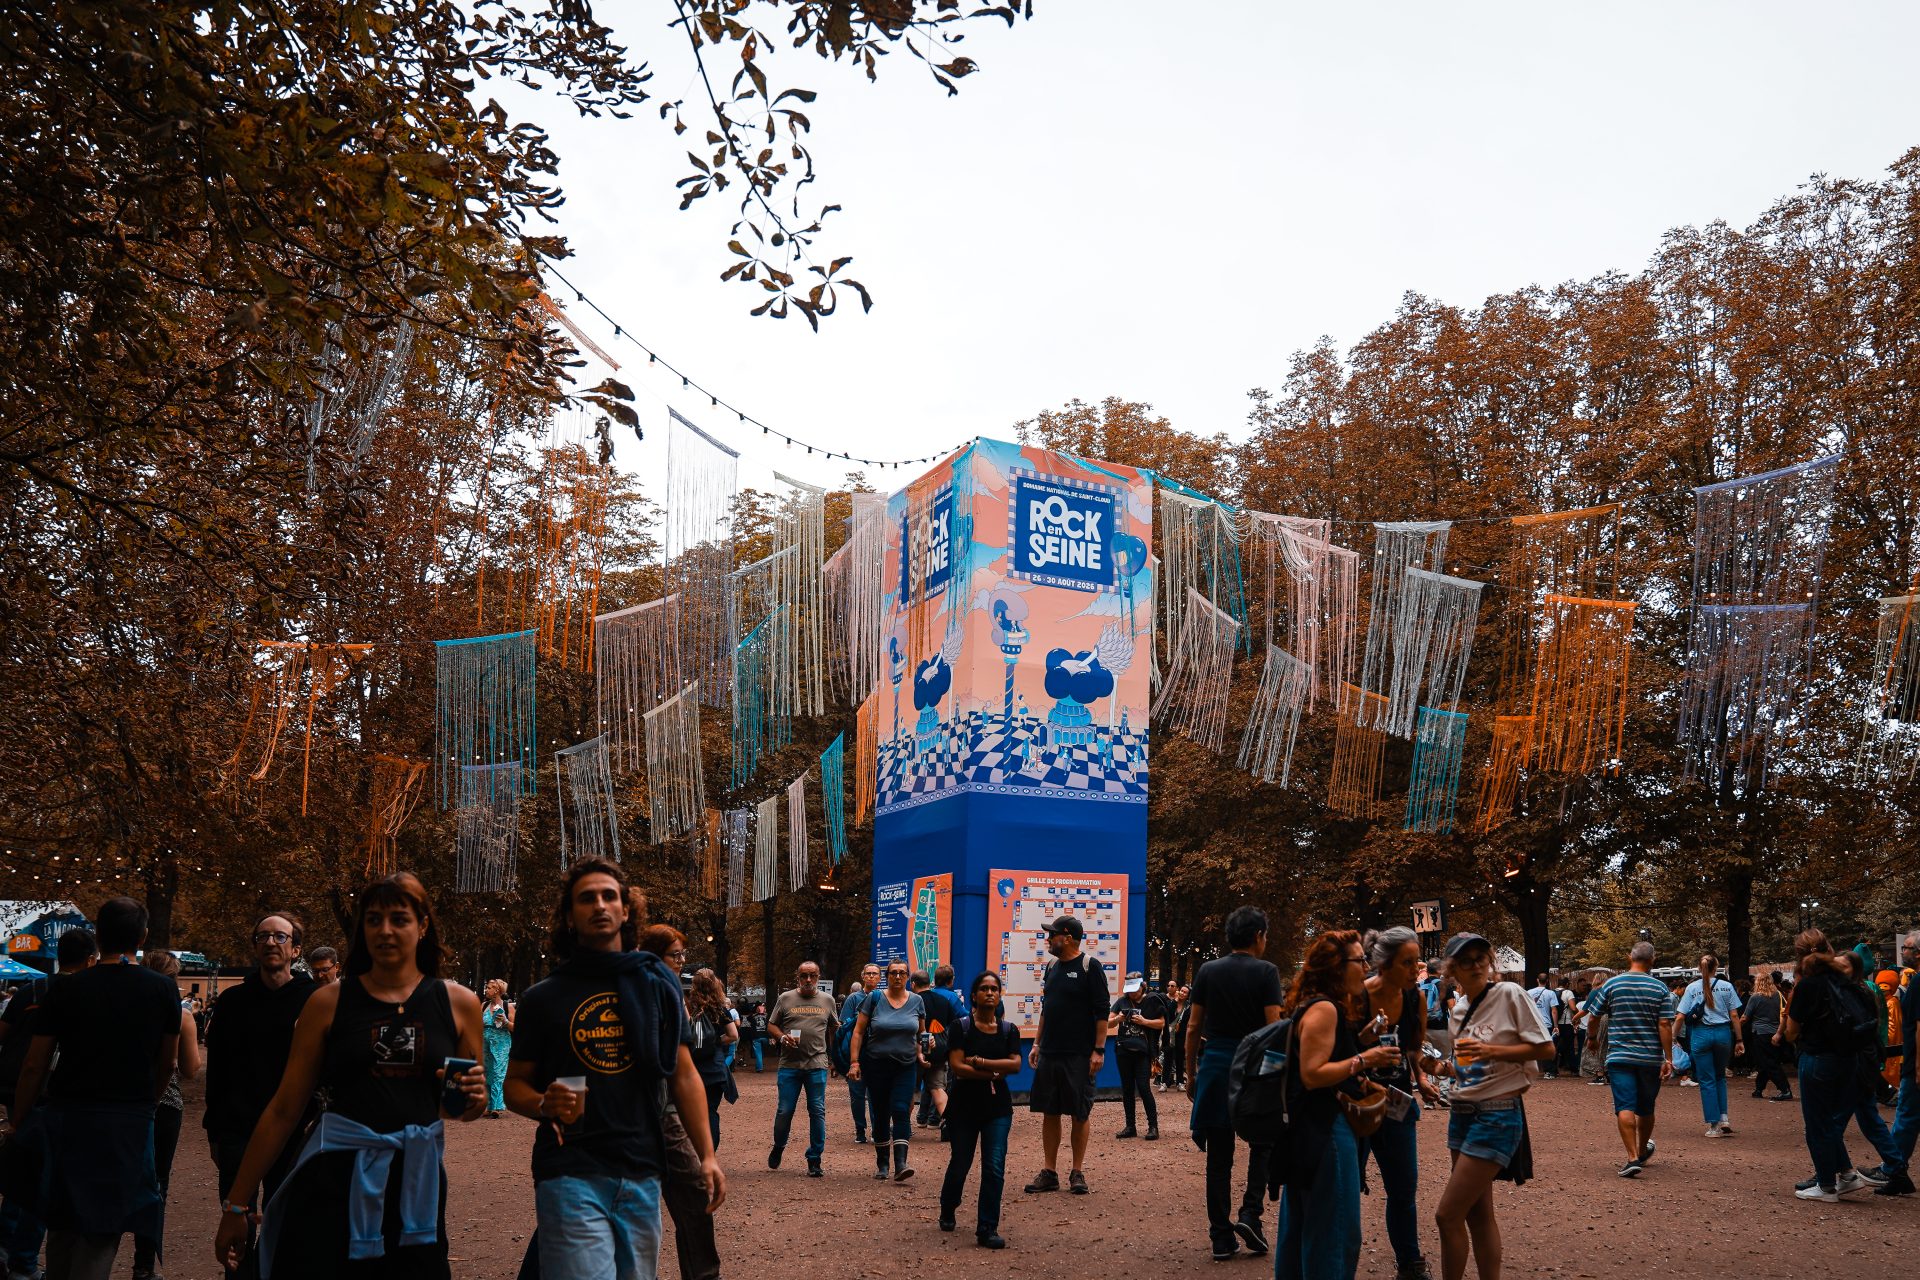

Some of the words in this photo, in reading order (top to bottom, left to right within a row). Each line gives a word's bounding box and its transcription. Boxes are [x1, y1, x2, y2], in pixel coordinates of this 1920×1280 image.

[1022, 482, 1046, 492] DOMAINE
[1046, 486, 1070, 497] NATIONAL
[1078, 492, 1111, 504] SAINT-CLOUD
[1029, 495, 1102, 543] ROCK
[1047, 525, 1063, 536] en
[1028, 533, 1102, 570] SEINE
[1032, 574, 1042, 582] 26
[1046, 576, 1056, 584] 30
[1057, 578, 1076, 587] AOÛT
[1076, 581, 1095, 590] 2026
[1055, 878, 1102, 886] PROGRAMMATION
[43, 924, 52, 938] LA
[15, 936, 31, 950] BAR
[578, 996, 610, 1021] Original
[575, 1025, 625, 1043] QuikSil
[582, 1047, 618, 1068] Mountain
